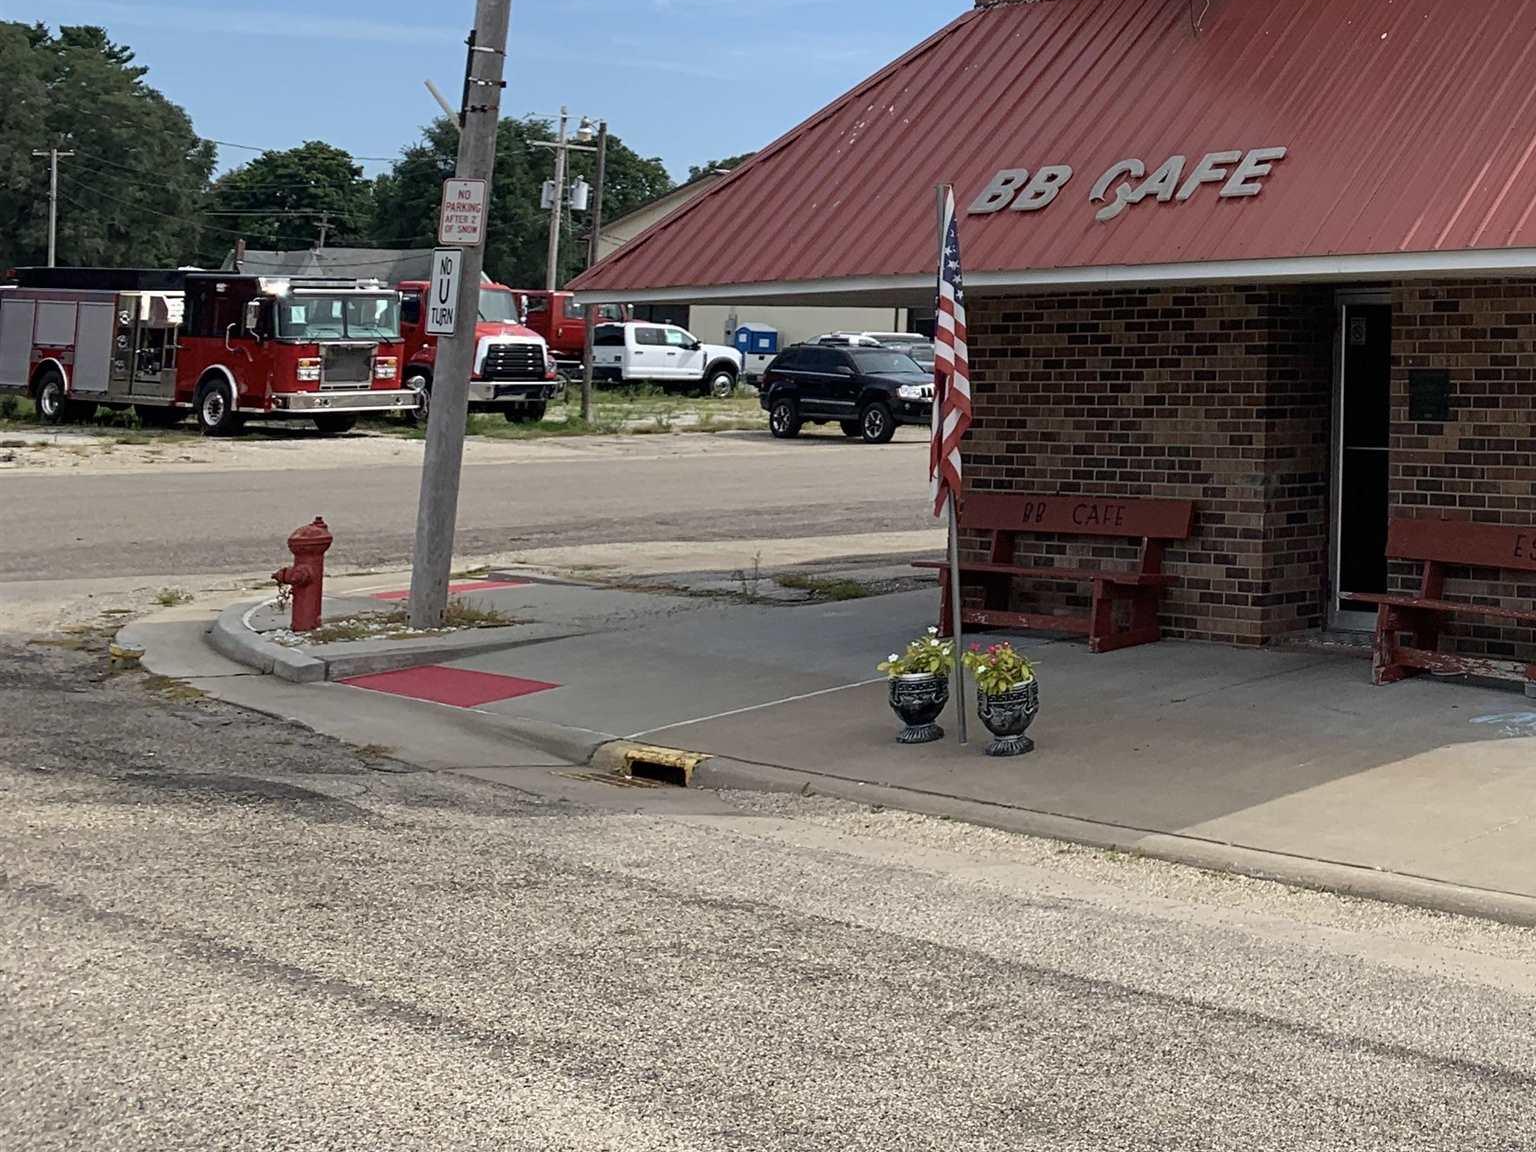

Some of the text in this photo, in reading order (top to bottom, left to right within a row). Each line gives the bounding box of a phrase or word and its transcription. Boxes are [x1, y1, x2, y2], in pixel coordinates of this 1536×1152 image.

[967, 147, 1288, 222] BB CAFE
[458, 189, 472, 200] NO
[445, 202, 481, 214] PARKING
[445, 215, 469, 224] AFTER
[457, 226, 478, 234] SNOW
[440, 257, 452, 276] NO
[439, 279, 450, 304] U
[431, 307, 453, 326] TURN
[1072, 503, 1126, 526] CAFE
